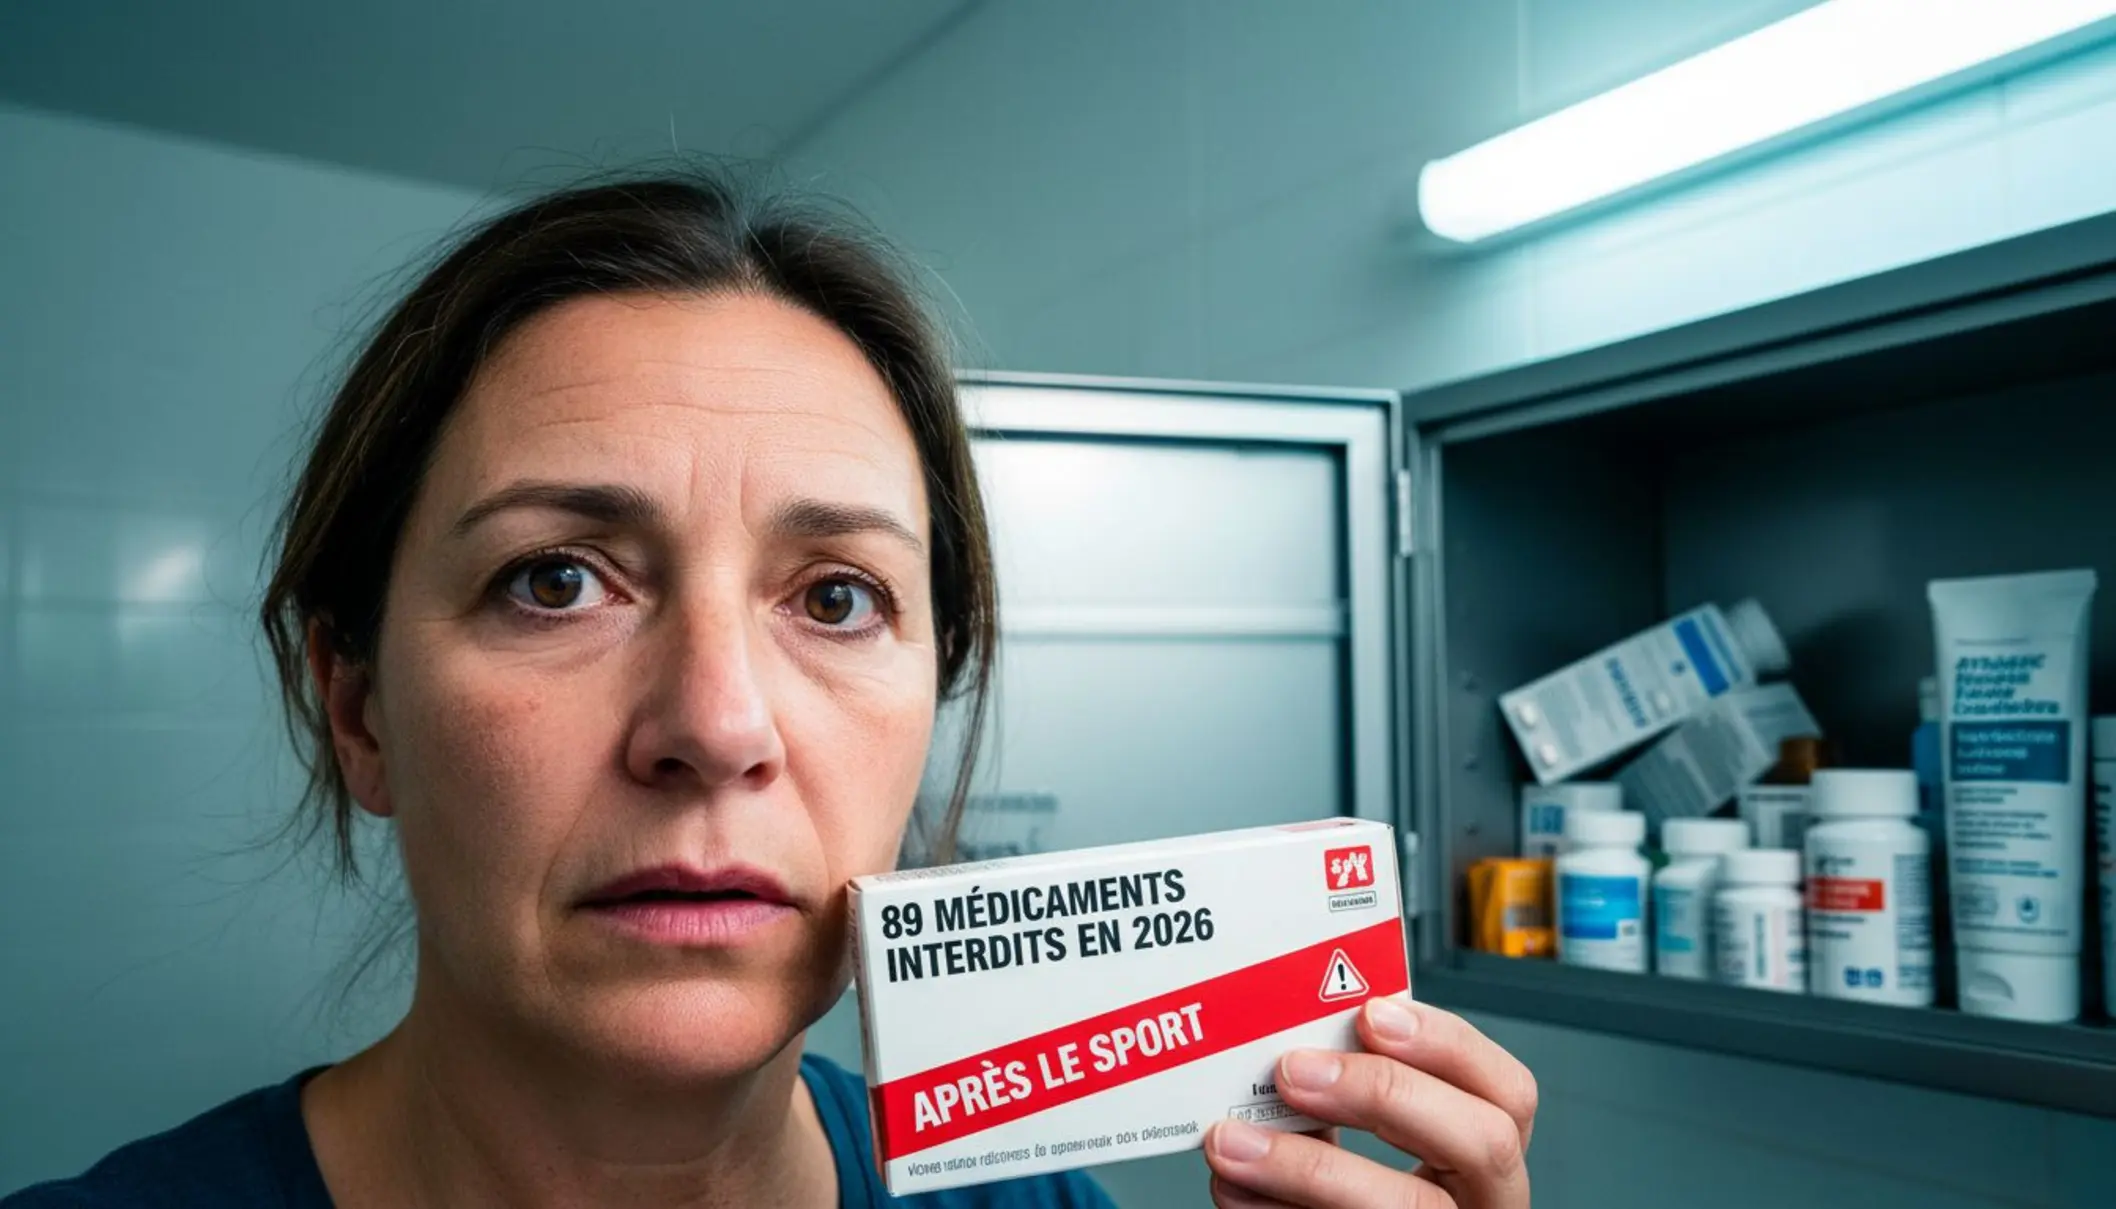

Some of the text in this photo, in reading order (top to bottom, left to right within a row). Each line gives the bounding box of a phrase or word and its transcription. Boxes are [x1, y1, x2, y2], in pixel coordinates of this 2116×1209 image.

[881, 902, 923, 939] 89
[934, 868, 1186, 932] MÉDICAMENTS
[886, 907, 1214, 982] INTERDITS EN 2026
[915, 1002, 1204, 1132] APRÈS LE SPORT
